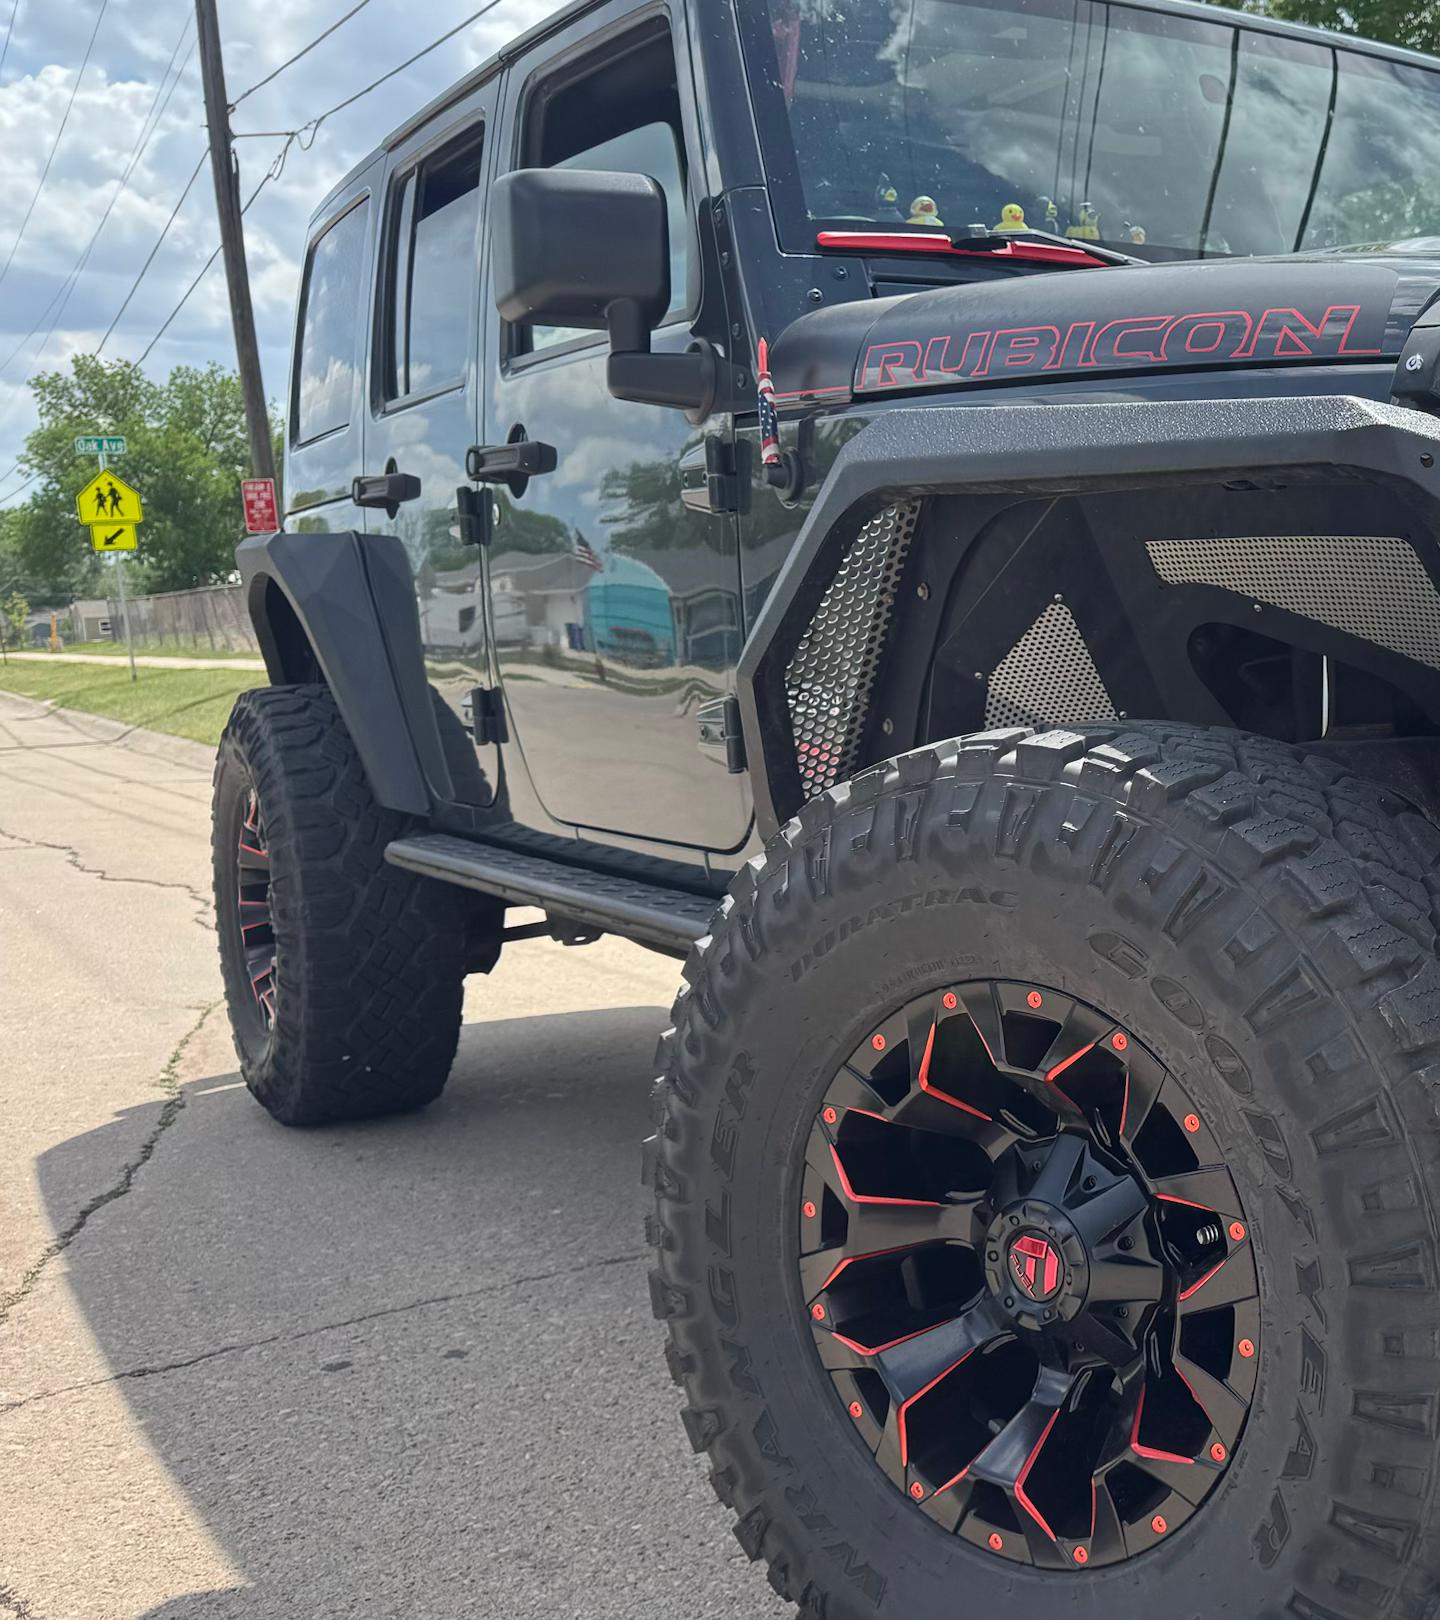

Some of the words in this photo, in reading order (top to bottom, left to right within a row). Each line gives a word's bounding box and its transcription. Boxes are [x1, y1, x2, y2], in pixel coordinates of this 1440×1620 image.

[854, 305, 1381, 389] RUBICON
[704, 1048, 890, 1610] WRANGLER
[1009, 1252, 1036, 1298] FUEL
[1088, 930, 1329, 1570] GOODYEAR
